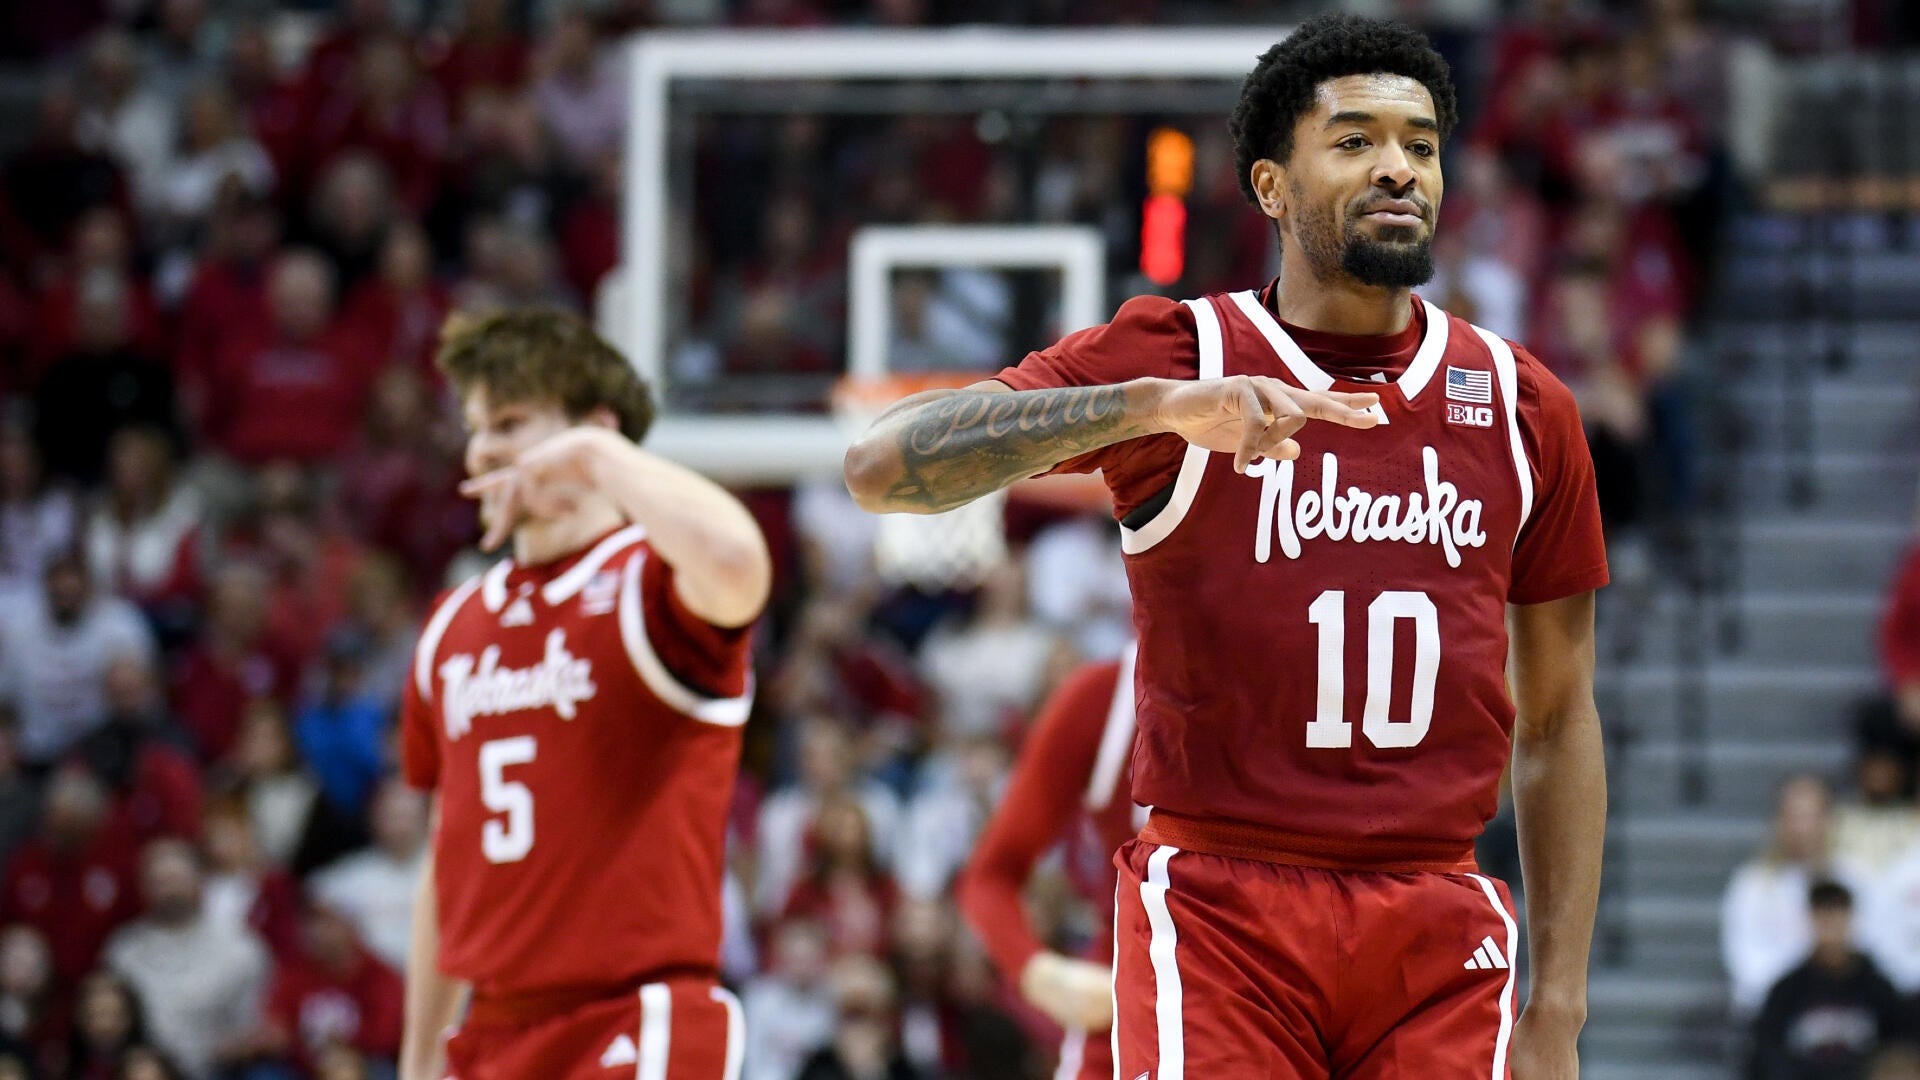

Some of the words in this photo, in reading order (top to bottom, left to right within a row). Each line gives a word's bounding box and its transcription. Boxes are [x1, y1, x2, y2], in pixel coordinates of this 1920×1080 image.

[1245, 446, 1486, 568] Nebraska
[439, 627, 596, 741] Nebraska
[1306, 590, 1440, 748] 10
[479, 735, 537, 864] 5
